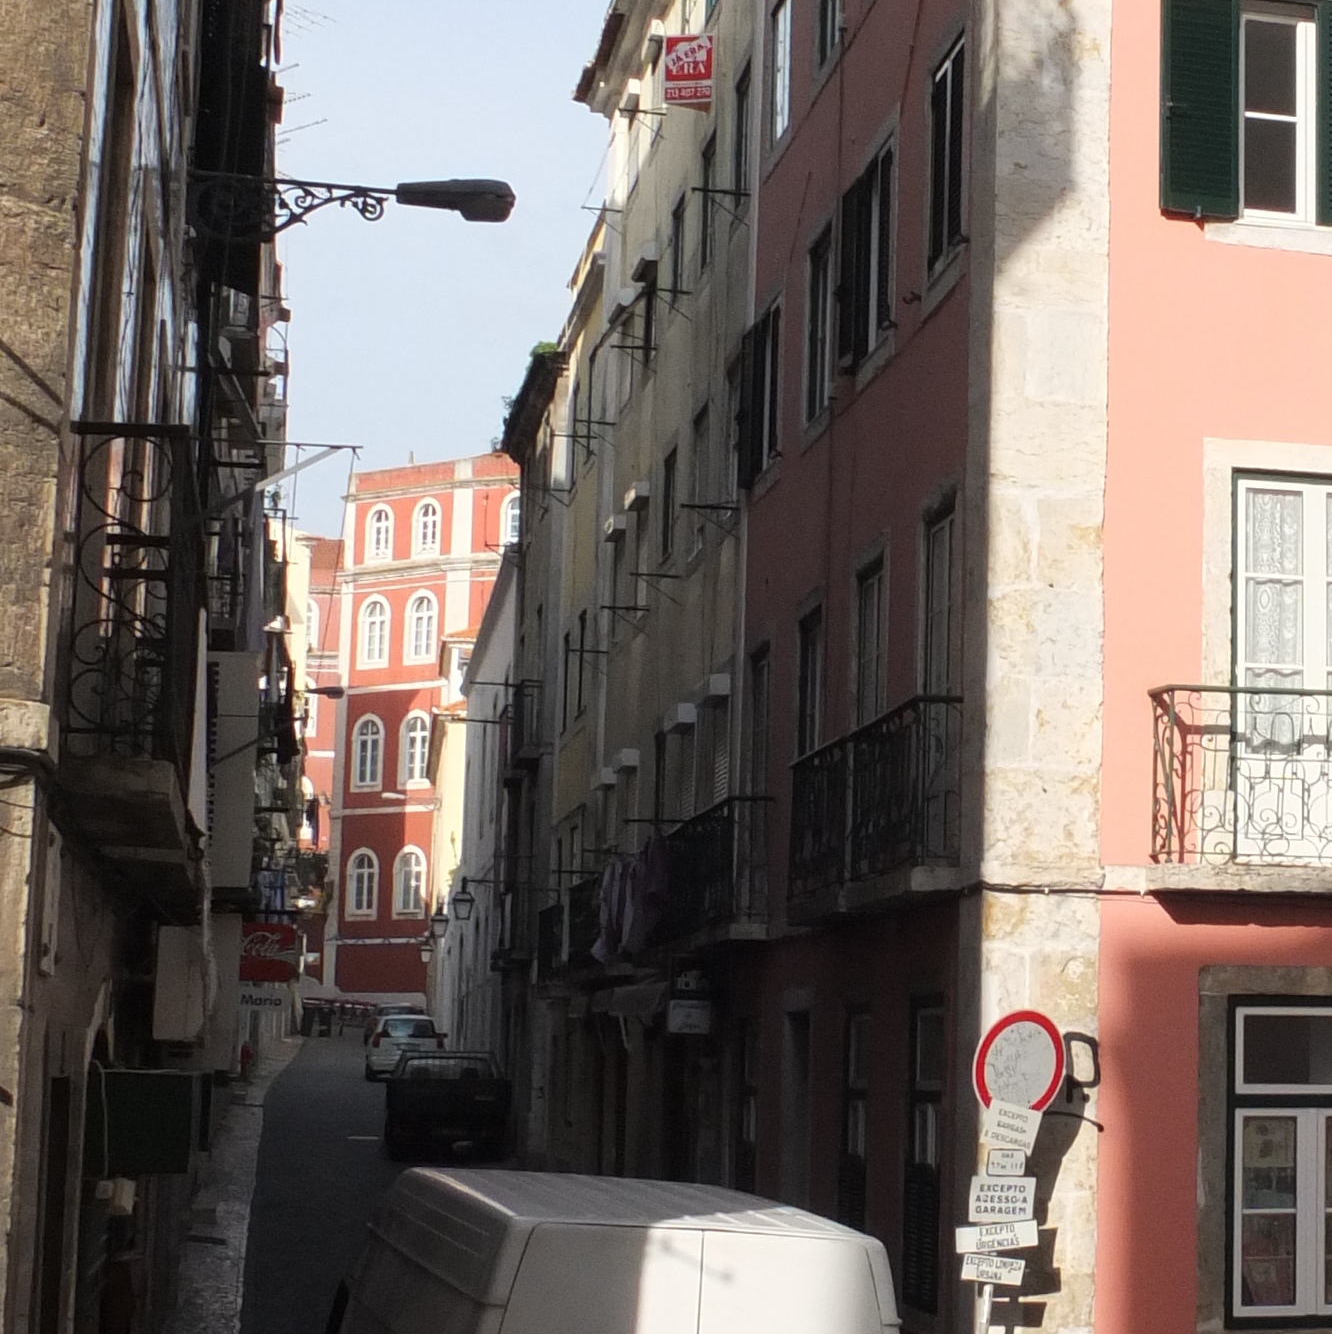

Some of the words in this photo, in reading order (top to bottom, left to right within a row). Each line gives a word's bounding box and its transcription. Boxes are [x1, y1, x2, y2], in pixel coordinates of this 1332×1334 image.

[241, 994, 282, 1006] Mario
[998, 1108, 1028, 1123] EXCEPTO
[991, 1131, 1031, 1150] DESCARGAS
[980, 1184, 1026, 1193] EXCEPTO
[975, 1194, 1019, 1204] ACESSO
[975, 1205, 1027, 1215] GARAGEM
[979, 1224, 1015, 1237] EXCEPTO
[966, 1255, 995, 1267] EXCEPTO
